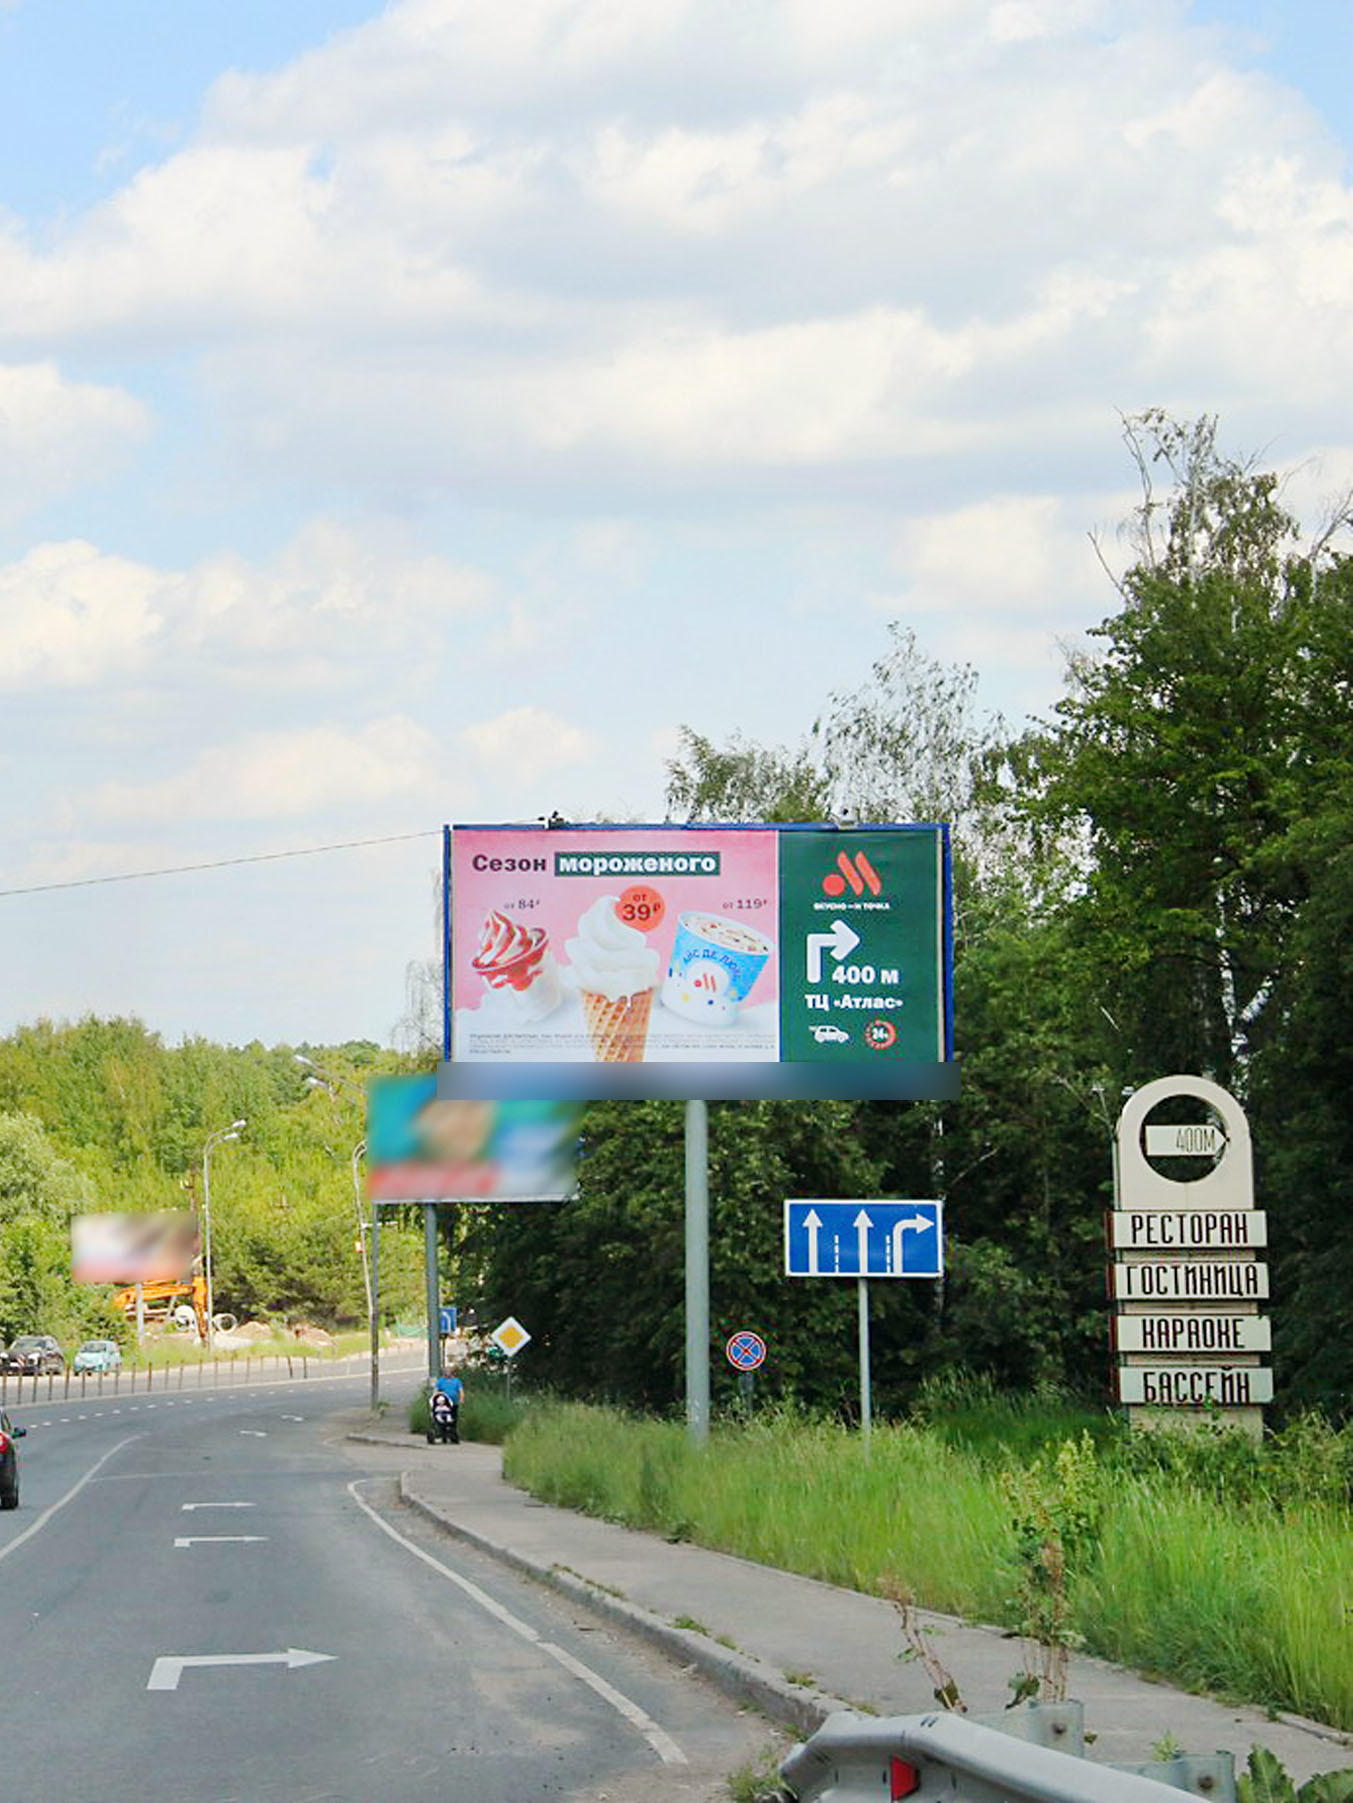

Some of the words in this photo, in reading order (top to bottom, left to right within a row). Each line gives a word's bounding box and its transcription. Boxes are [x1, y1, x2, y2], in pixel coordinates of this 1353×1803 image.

[472, 854, 546, 872] Сезон
[558, 857, 716, 876] мороженого
[832, 965, 876, 984] 400
[804, 994, 829, 1011] ТЦ
[833, 994, 903, 1009] «Атлас»
[1176, 1127, 1216, 1153] 400М
[1130, 1213, 1249, 1244] РЕСТОРАН
[1126, 1264, 1259, 1296] ГОСТИНИЦА
[1142, 1318, 1245, 1349] КАРАОКЕ
[1143, 1366, 1250, 1403] БАССЕЙН
